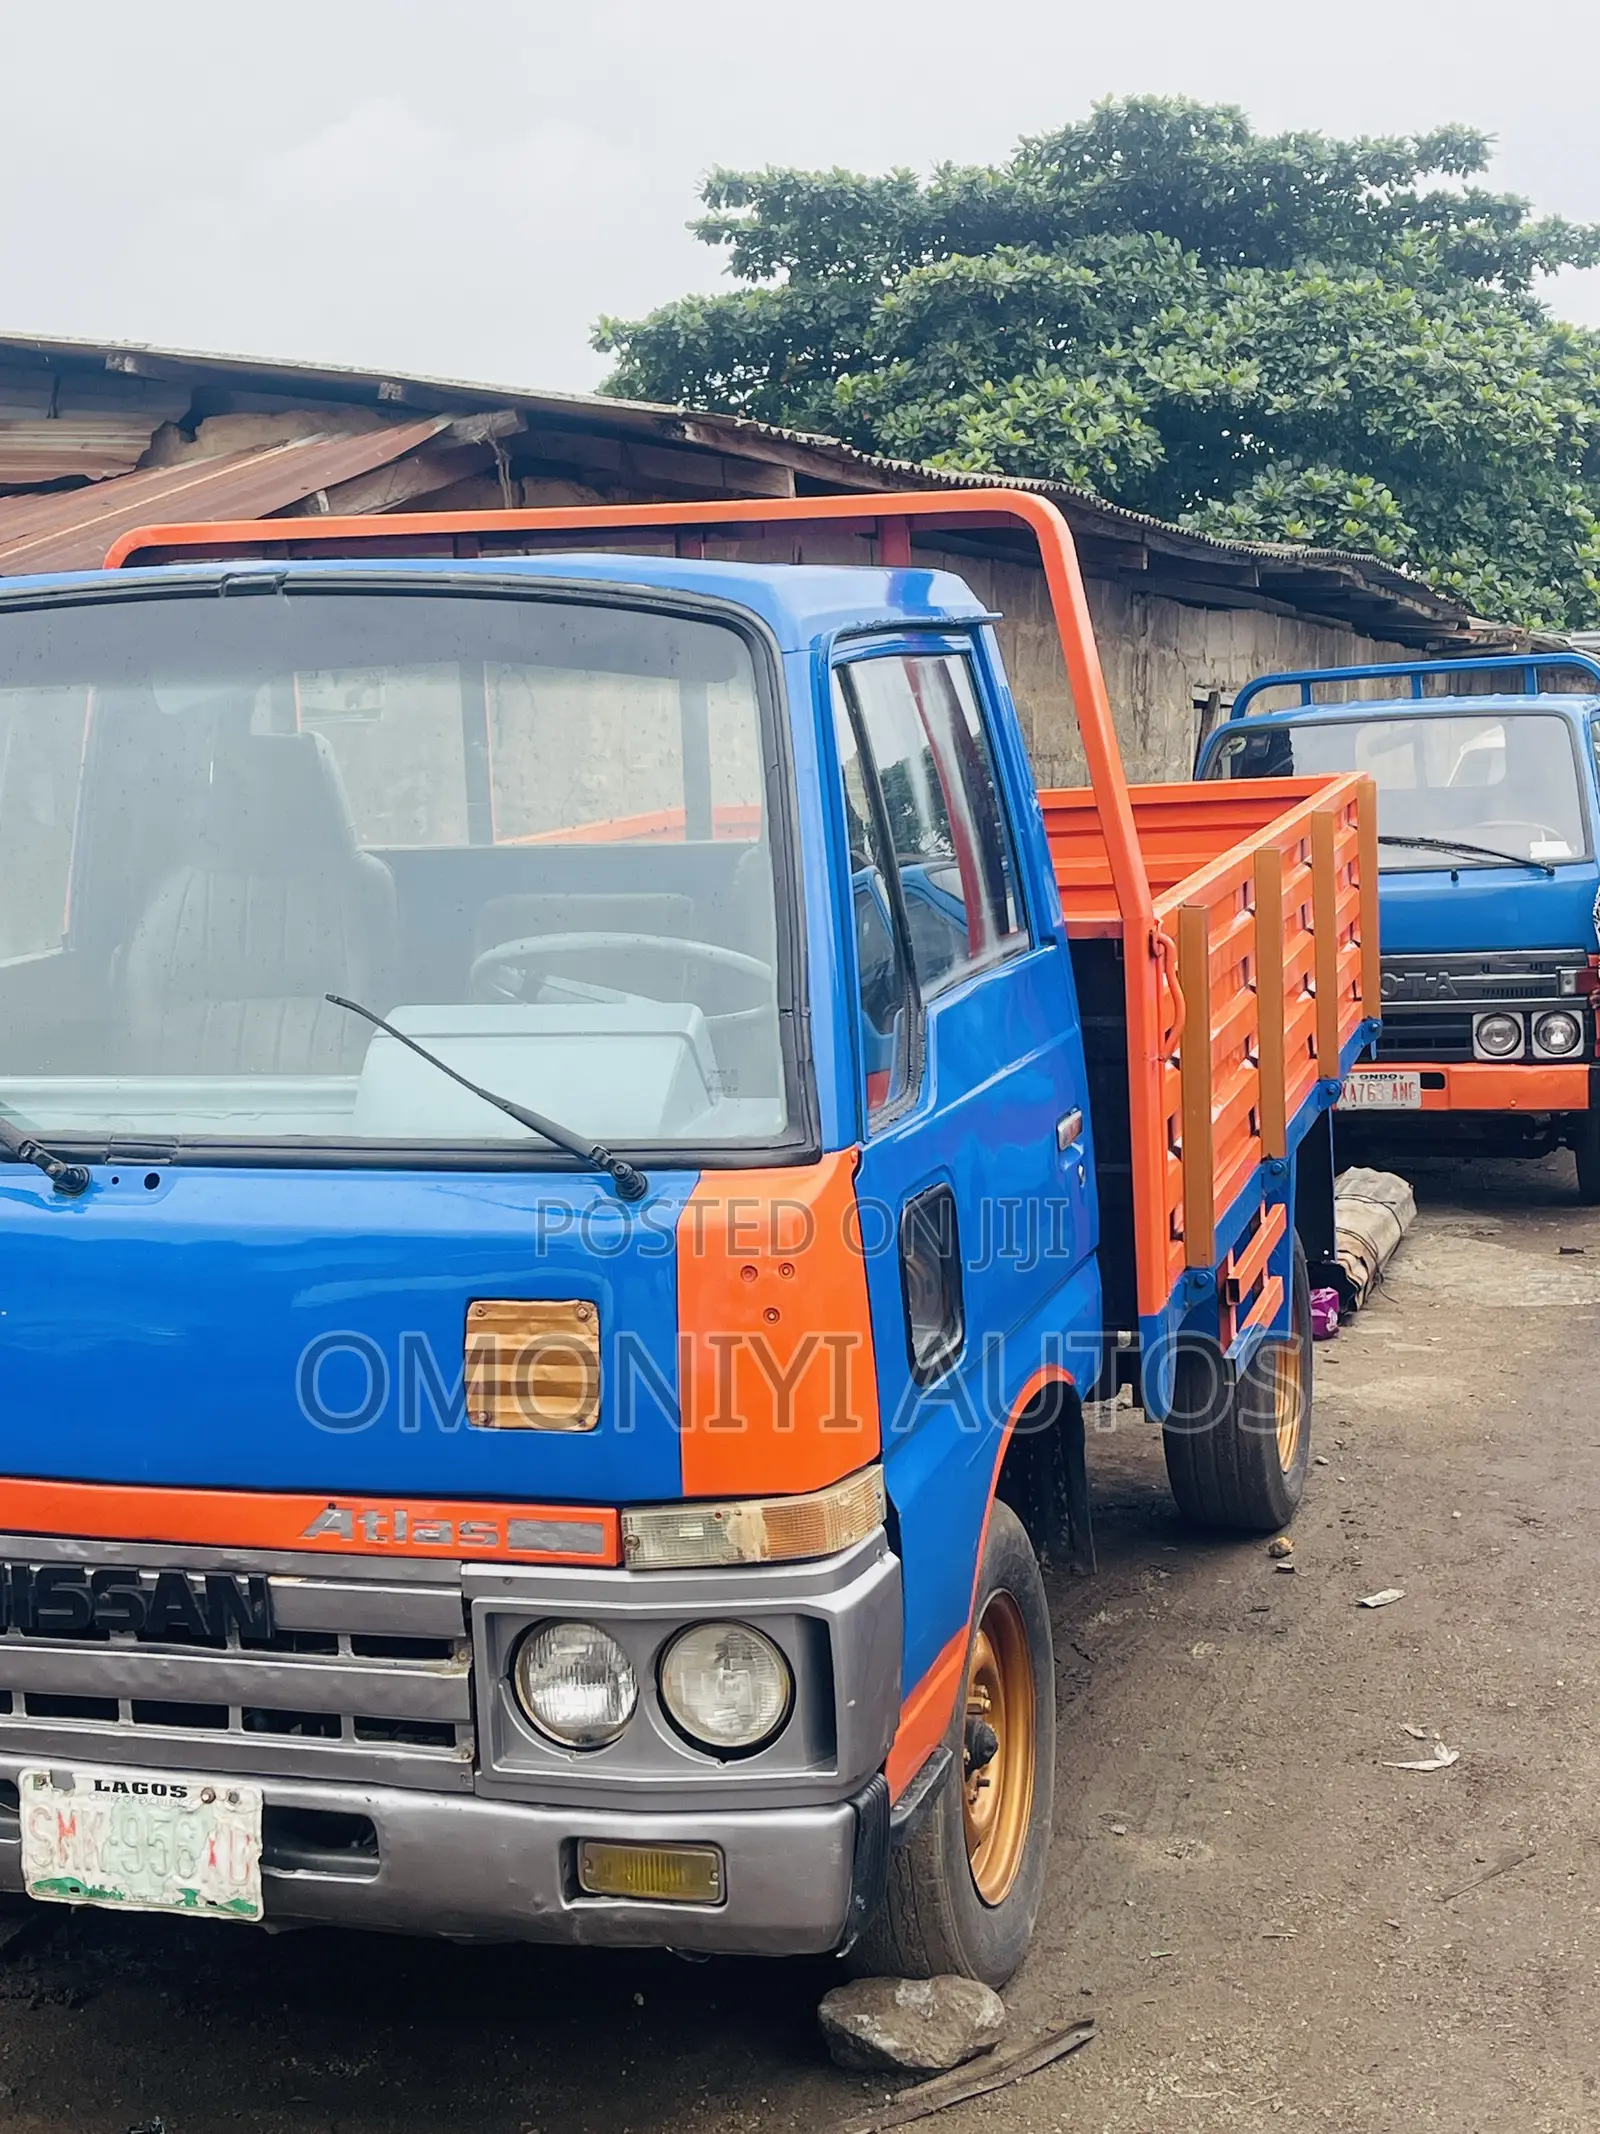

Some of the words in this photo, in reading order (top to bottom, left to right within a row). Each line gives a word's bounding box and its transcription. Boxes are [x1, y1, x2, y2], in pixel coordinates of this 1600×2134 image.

[1380, 971, 1458, 998] OTA
[299, 1507, 498, 1545] Atlas
[93, 1779, 188, 1798] LAGOS
